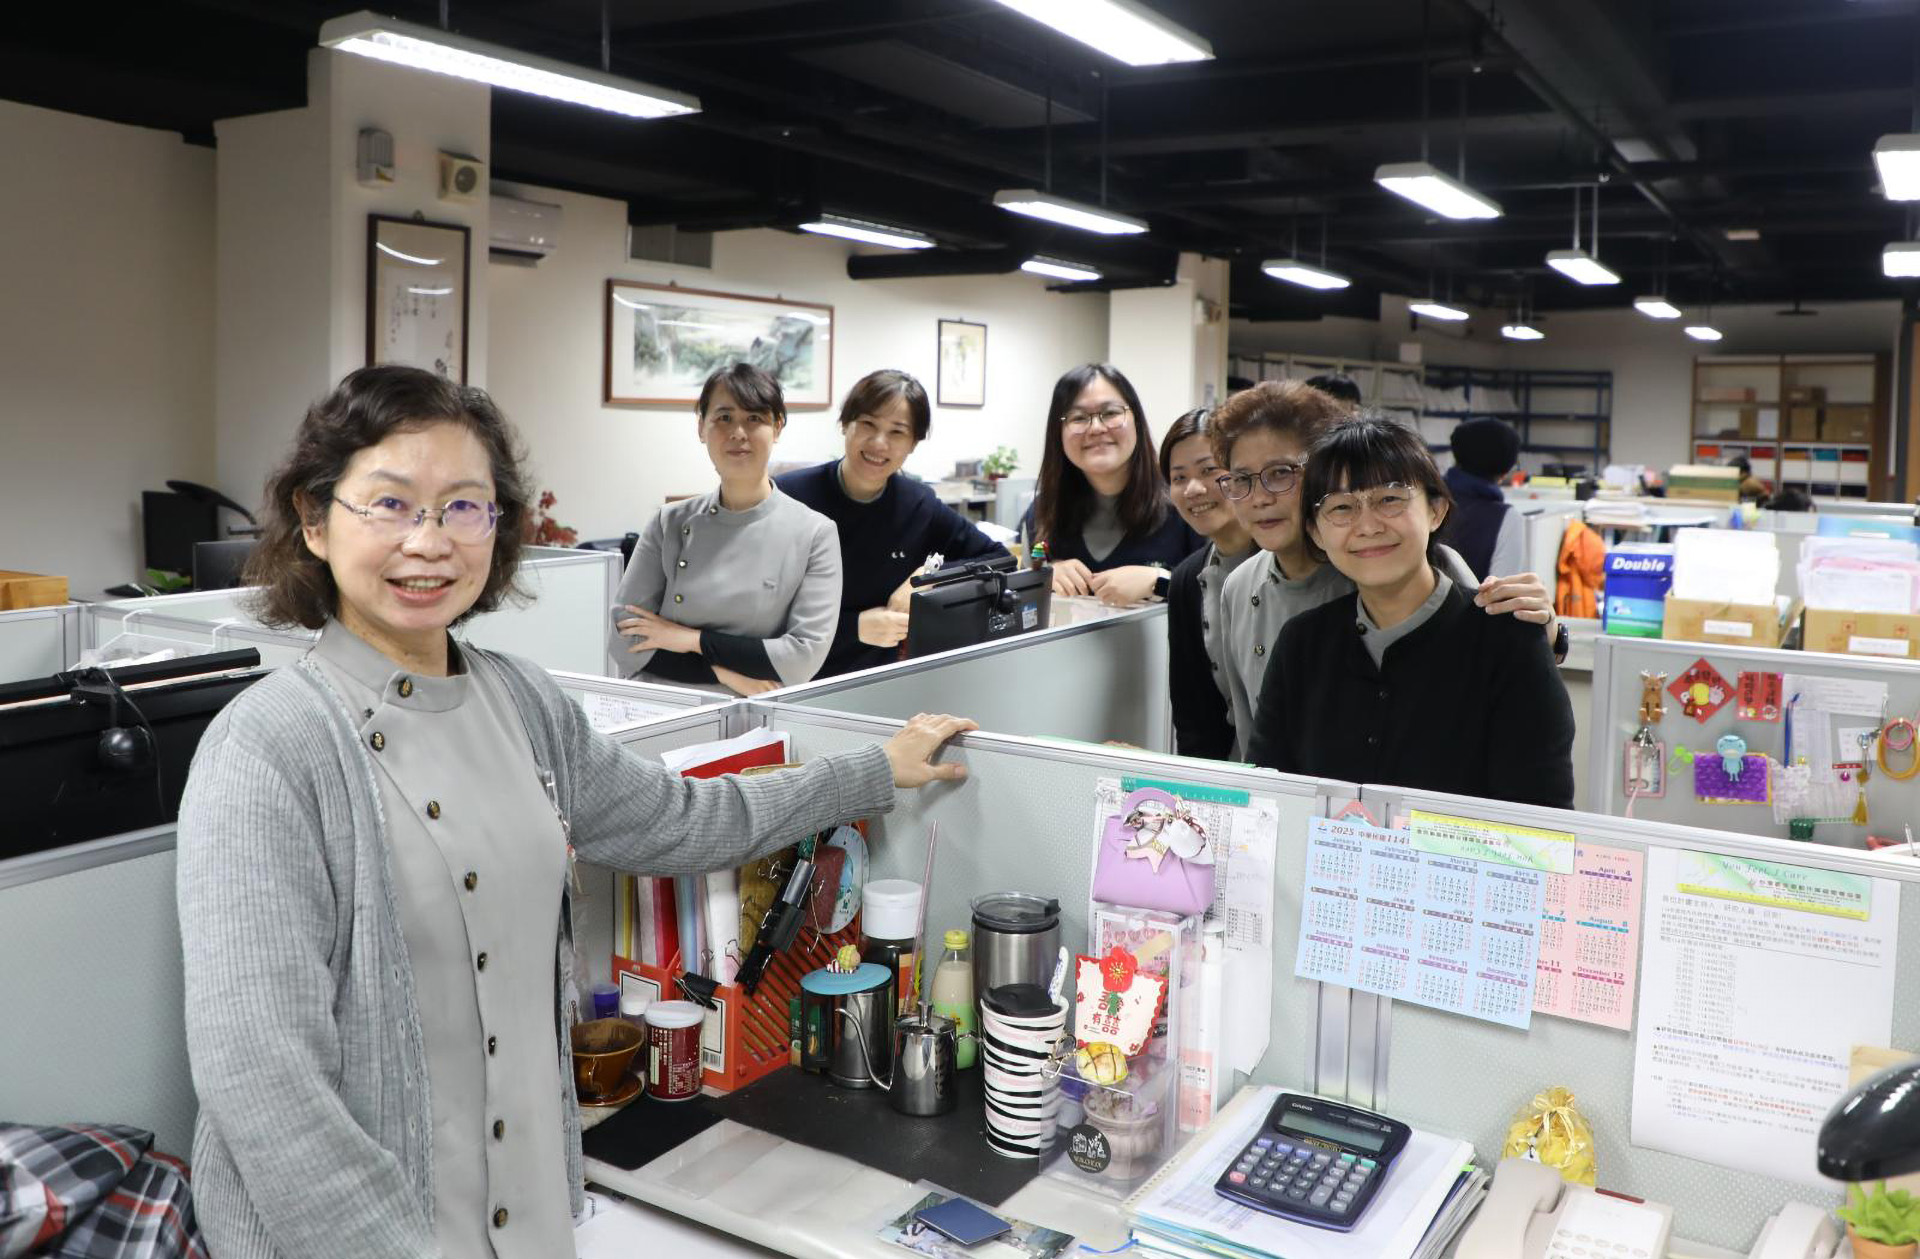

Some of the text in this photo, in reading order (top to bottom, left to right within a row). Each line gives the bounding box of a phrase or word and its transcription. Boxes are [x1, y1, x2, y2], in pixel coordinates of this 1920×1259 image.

[1612, 556, 1666, 572] Double
[1331, 826, 1354, 836] 2025
[1599, 867, 1616, 875] April
[1578, 966, 1624, 979] December 12
